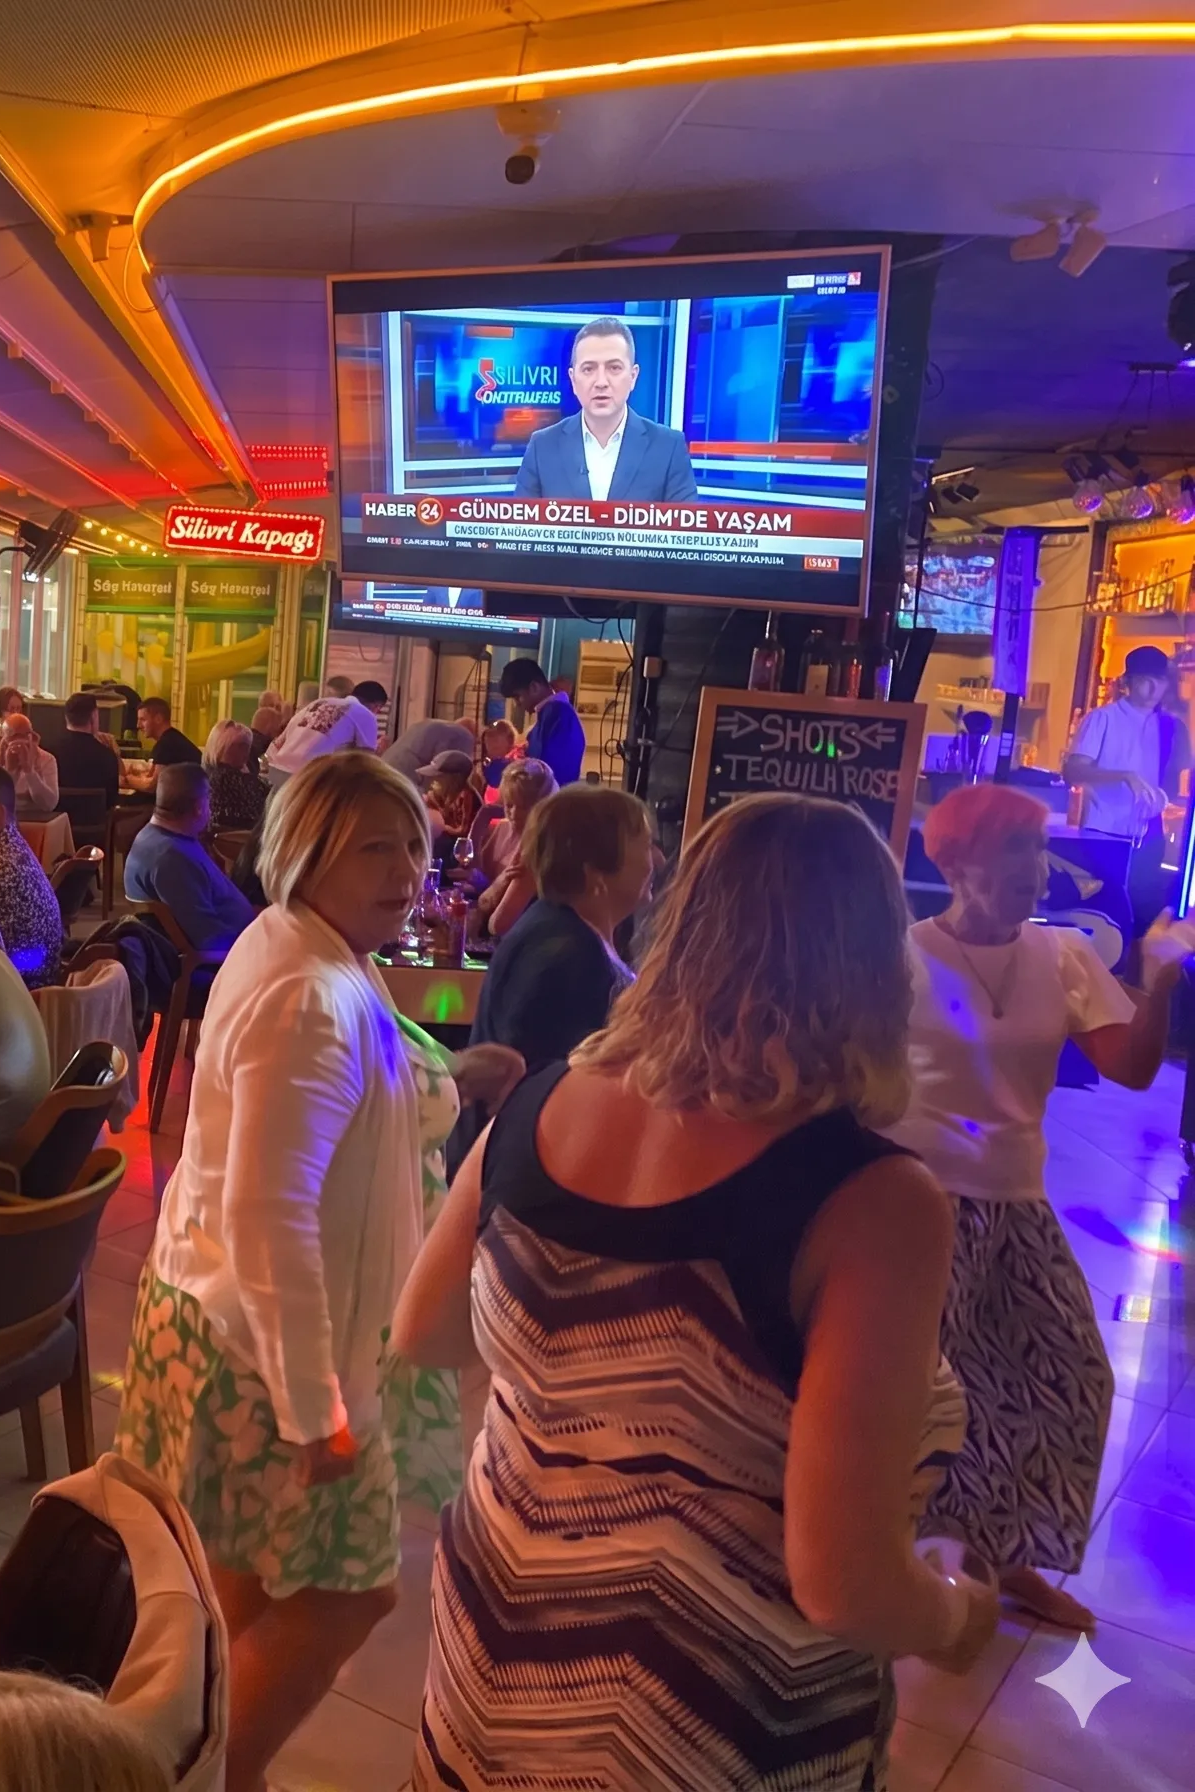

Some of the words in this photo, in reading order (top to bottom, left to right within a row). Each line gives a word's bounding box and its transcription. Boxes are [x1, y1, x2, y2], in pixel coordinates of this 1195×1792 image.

[365, 503, 417, 518] HABER
[420, 504, 440, 520] 24
[545, 501, 595, 524] ÖZEL
[714, 510, 792, 534] YAŞAM
[761, 713, 861, 761] SHOTS
